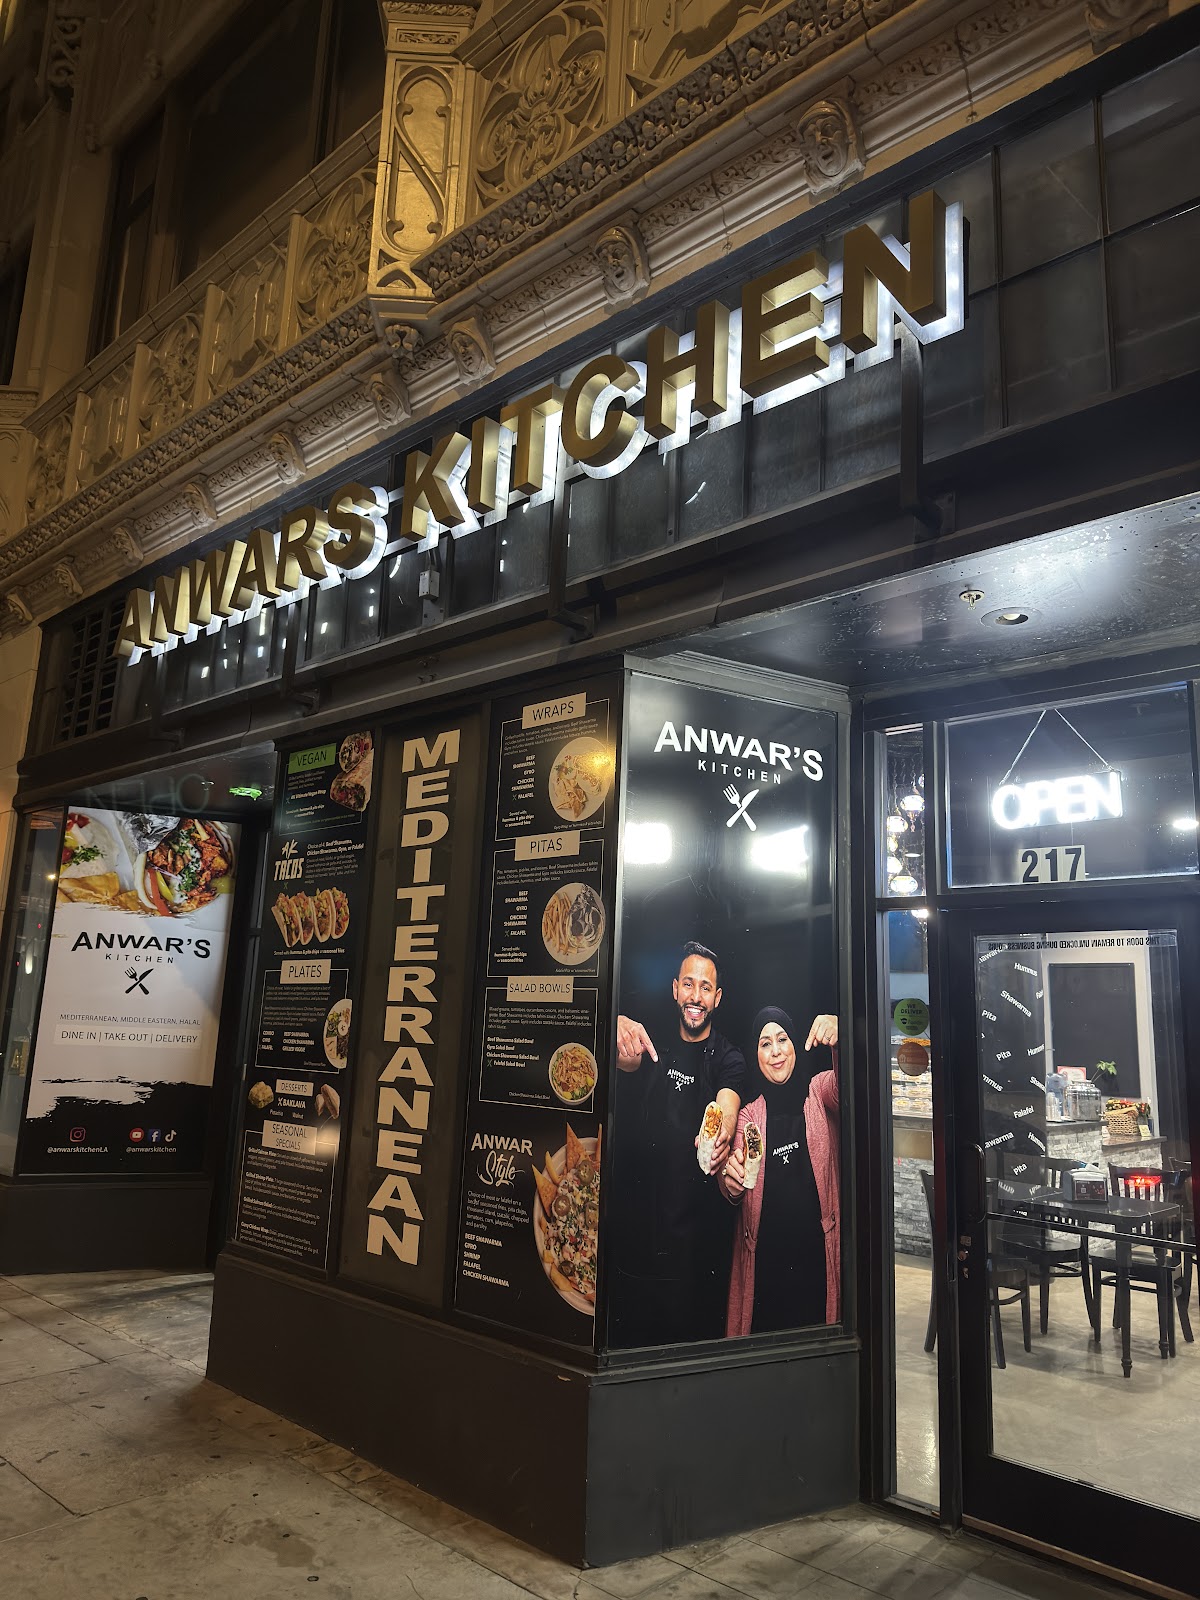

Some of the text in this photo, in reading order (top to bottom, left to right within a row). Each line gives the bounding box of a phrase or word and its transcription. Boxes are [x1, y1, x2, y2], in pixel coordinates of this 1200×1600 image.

[114, 190, 960, 662] ANWARS KITCHEN
[532, 700, 574, 721] WRAPS
[653, 720, 824, 782] ANWAR'S
[296, 750, 327, 767] VEGAN
[697, 759, 781, 785] KITCHEN
[990, 770, 1124, 830] OPEN
[530, 837, 563, 854] PITAS
[274, 857, 305, 882] TACOS
[1020, 847, 1082, 883] 217
[71, 931, 211, 959] ANWAR'S
[105, 953, 174, 964] KITCHEN
[288, 965, 322, 978] PLATES
[509, 983, 570, 994] SALAD BOWLS
[366, 728, 461, 1266] MEDITERRANEAN
[1000, 990, 1032, 1018] Shawarma
[982, 1010, 997, 1022] Pita
[61, 1030, 85, 1039] DINE
[86, 1032, 96, 1040] IN
[104, 1032, 126, 1041] TAKE
[128, 1033, 148, 1042] OUT
[155, 1034, 198, 1043] DELIVERY
[996, 1049, 1012, 1062] Pita
[281, 1082, 307, 1092] DESSERTS
[283, 1099, 306, 1108] BAKLAVA
[1013, 1105, 1034, 1119] Falafel
[272, 1124, 307, 1138] SEASONAL
[275, 1138, 301, 1150] SPECIALS
[471, 1132, 533, 1156] ANWAR
[476, 1150, 525, 1188] Style
[1013, 1163, 1027, 1176] Pita
[464, 1242, 477, 1250] GYRO
[465, 1233, 502, 1248] BEEF SHAWARMA
[463, 1251, 480, 1261] SHRIMP
[463, 1260, 482, 1270] FALAFEL
[462, 1269, 482, 1280] CHICKEN
